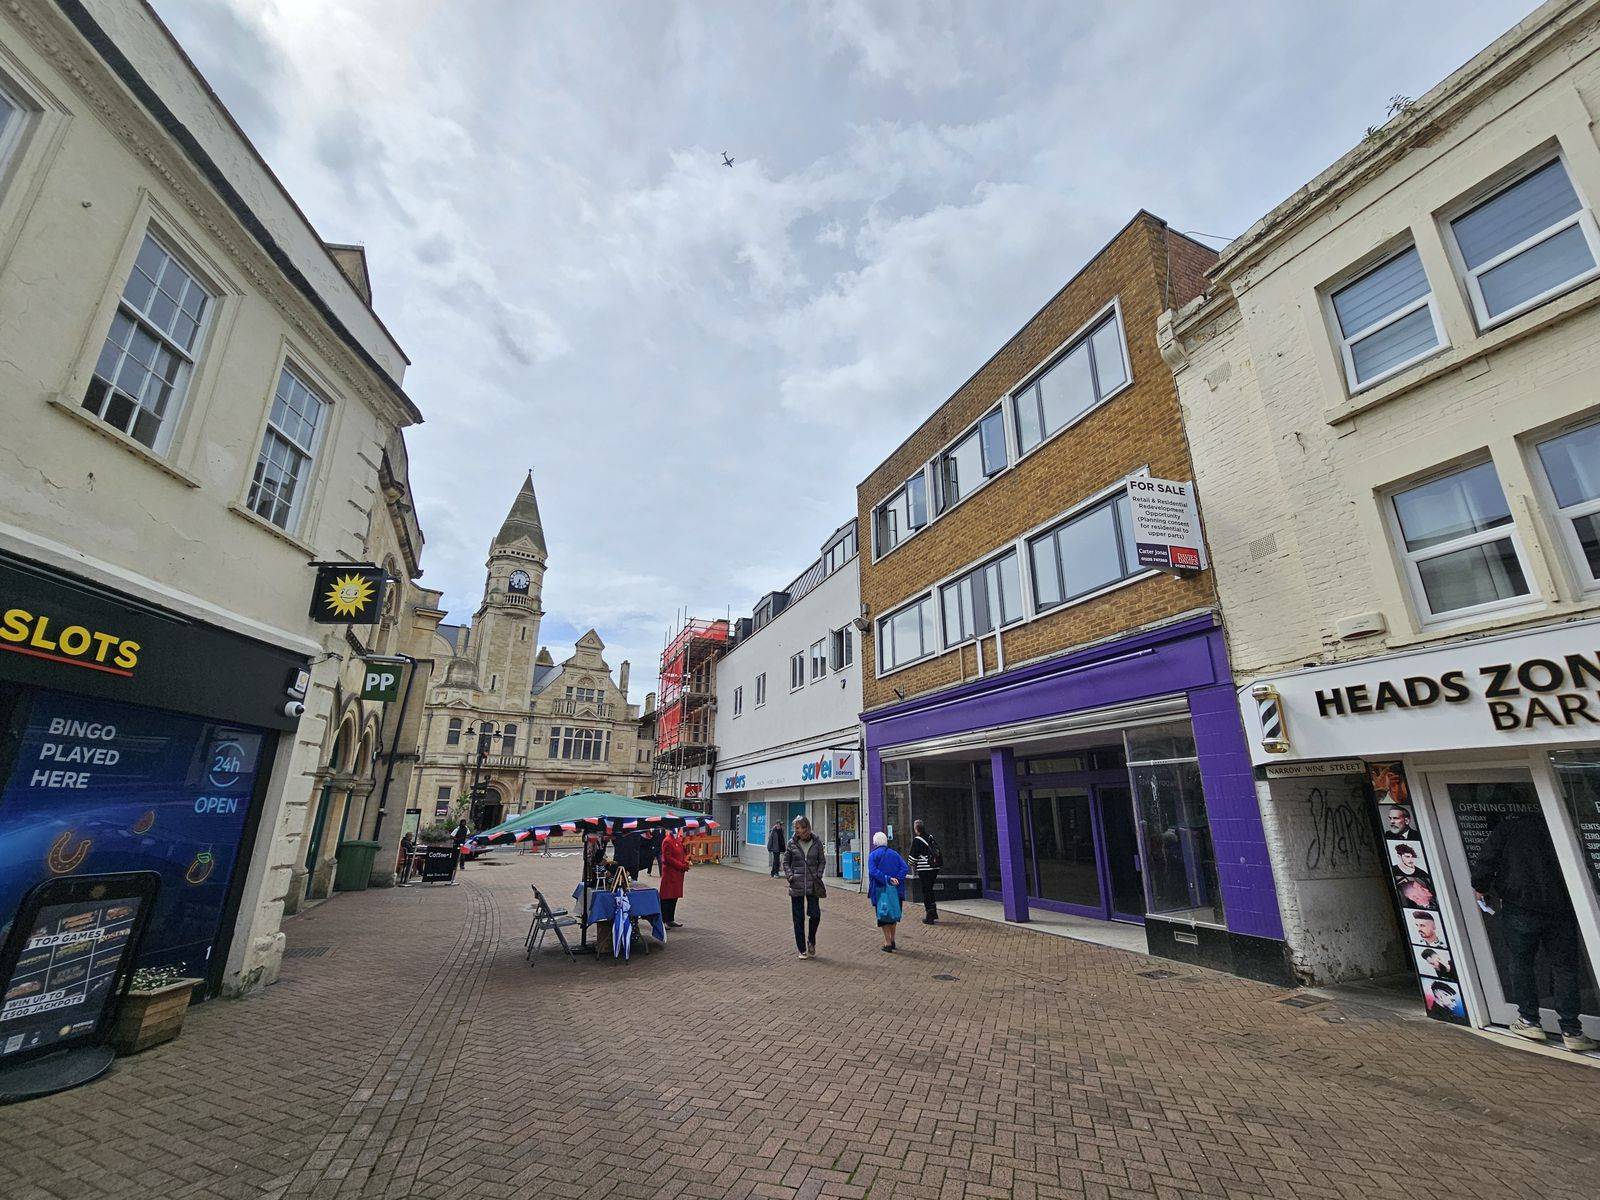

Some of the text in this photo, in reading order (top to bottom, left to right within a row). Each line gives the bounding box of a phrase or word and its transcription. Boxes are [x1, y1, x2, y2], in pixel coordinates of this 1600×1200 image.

[1130, 480, 1186, 496] FOR SALE
[1138, 503, 1185, 514] Redevelopment
[1157, 498, 1188, 508] Residential
[1137, 516, 1190, 527] (Planning consent
[1145, 510, 1181, 520] Opportunity
[1151, 524, 1181, 532] residential
[1167, 532, 1185, 540] parts)
[1154, 548, 1168, 556] Jonas
[0, 608, 141, 669] SLOTS
[365, 672, 395, 692] PP
[1315, 670, 1470, 717] HEADS
[1488, 689, 1600, 731] BAR
[48, 717, 117, 741] BINGO
[39, 743, 120, 766] PLAYED
[212, 756, 241, 773] 24h
[1268, 763, 1361, 776] NARROW WINE STREET
[29, 769, 91, 789] HERE
[725, 771, 746, 790] savers
[194, 797, 238, 814] OPEN
[1459, 803, 1540, 813] OPENING TIMES
[34, 937, 60, 947] TOP
[61, 930, 102, 943] GAMES
[8, 991, 63, 1009] WIN UP TO
[31, 995, 85, 1013] JACKPOTS
